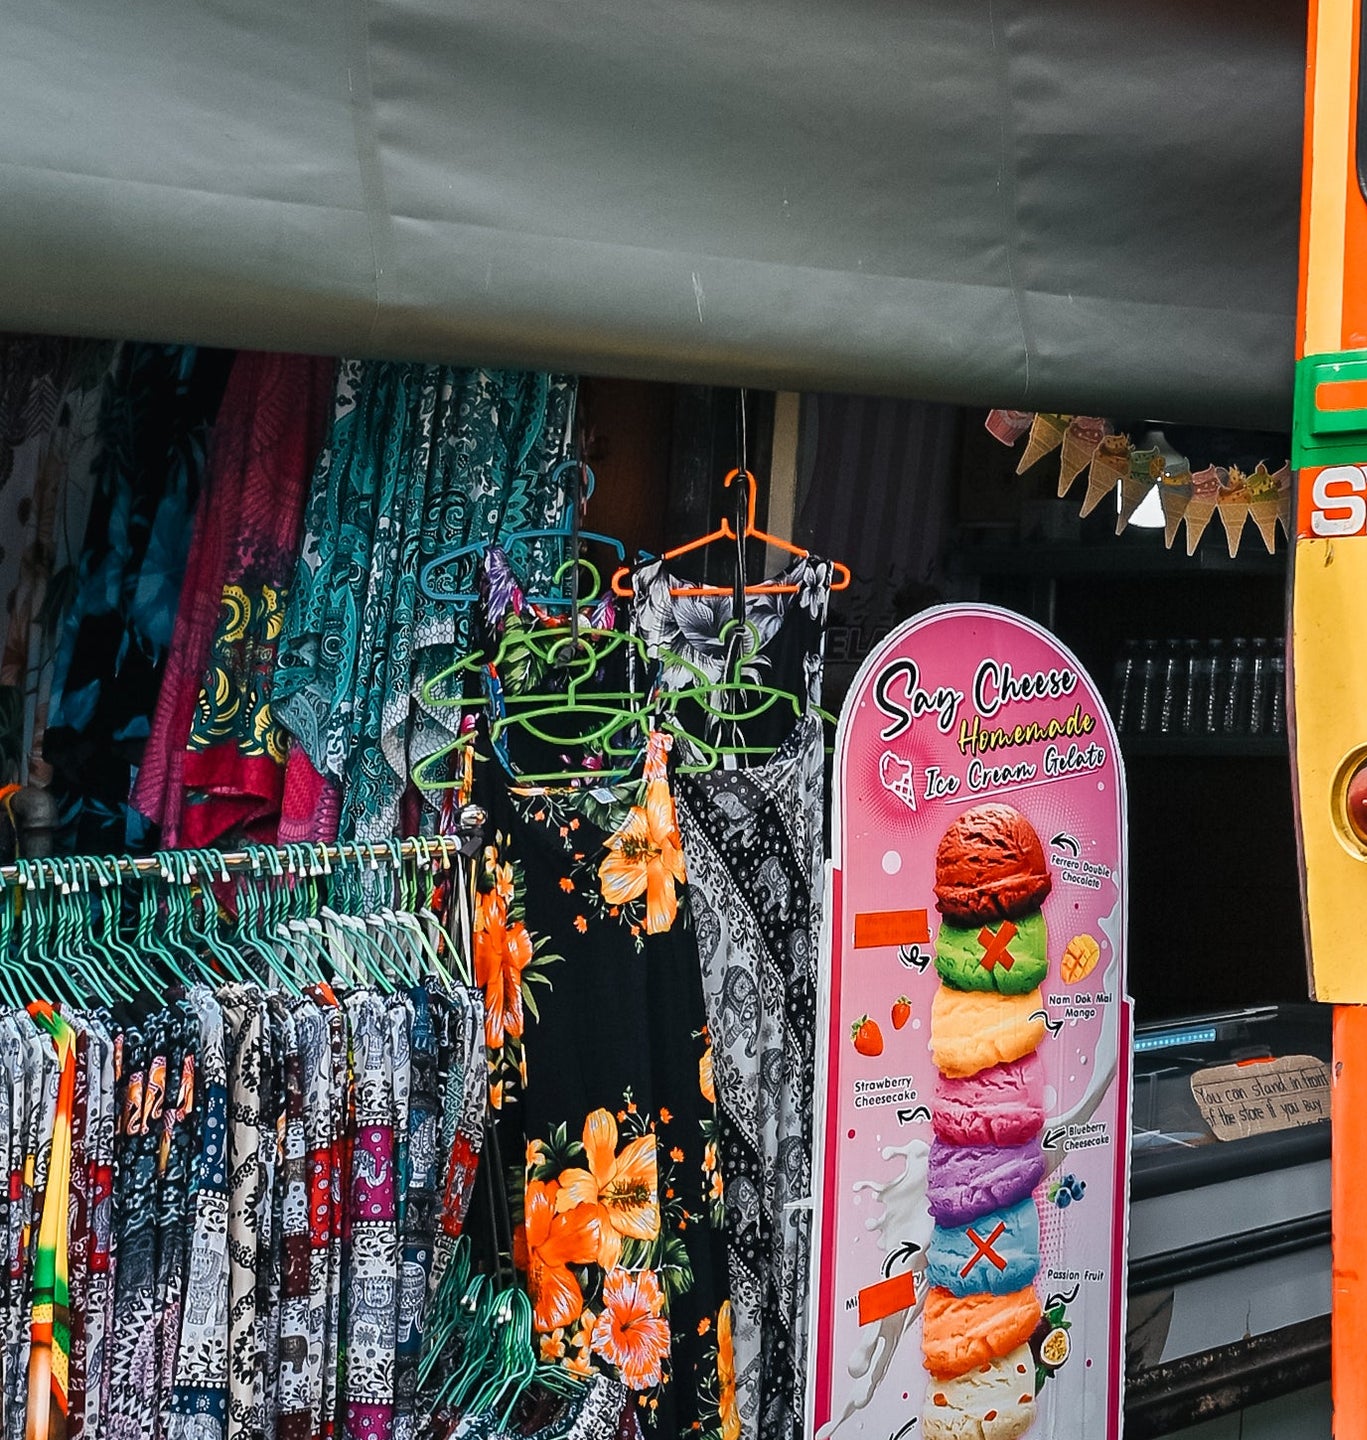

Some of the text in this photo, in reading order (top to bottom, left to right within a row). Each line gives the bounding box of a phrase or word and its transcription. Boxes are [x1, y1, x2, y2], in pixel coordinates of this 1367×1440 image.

[875, 658, 1077, 739] Say Cheese
[957, 703, 1096, 754] Homemade
[925, 743, 1106, 798] Ice Cream Gelato
[1051, 854, 1111, 878] Ferrero Double
[1062, 871, 1101, 889] Chocolate
[1048, 995, 1071, 1005] Nam
[1075, 994, 1092, 1004] Dok
[1065, 1008, 1096, 1020] Mango
[854, 1077, 912, 1093] Strawberry
[1195, 1067, 1330, 1105] You can stand in front
[854, 1090, 917, 1108] Cheesecake
[1219, 1106, 1236, 1126] the
[1240, 1101, 1264, 1122] store
[1280, 1101, 1300, 1122] you
[1069, 1123, 1107, 1136] Blueberry
[1064, 1135, 1110, 1151] Cheesecake
[1047, 1268, 1105, 1281] Passion Fruit
